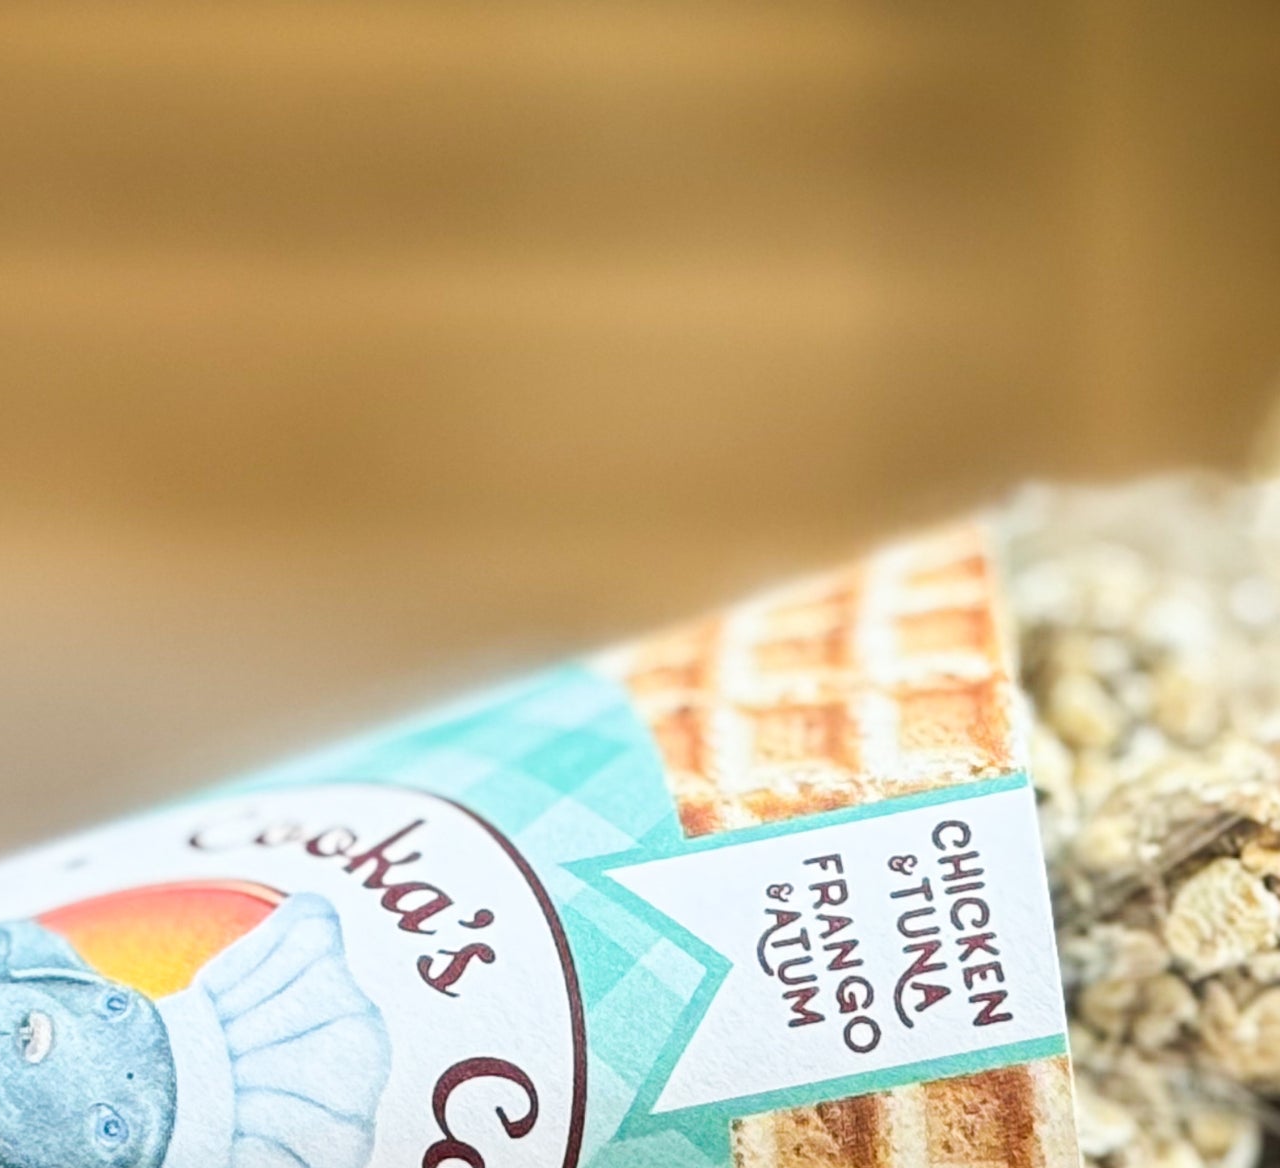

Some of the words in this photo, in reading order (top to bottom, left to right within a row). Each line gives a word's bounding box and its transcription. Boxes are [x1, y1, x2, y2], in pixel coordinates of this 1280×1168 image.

[187, 806, 496, 998] Cooka's
[803, 853, 882, 1054] FRANGO
[931, 819, 1014, 1028] CHICKEN
